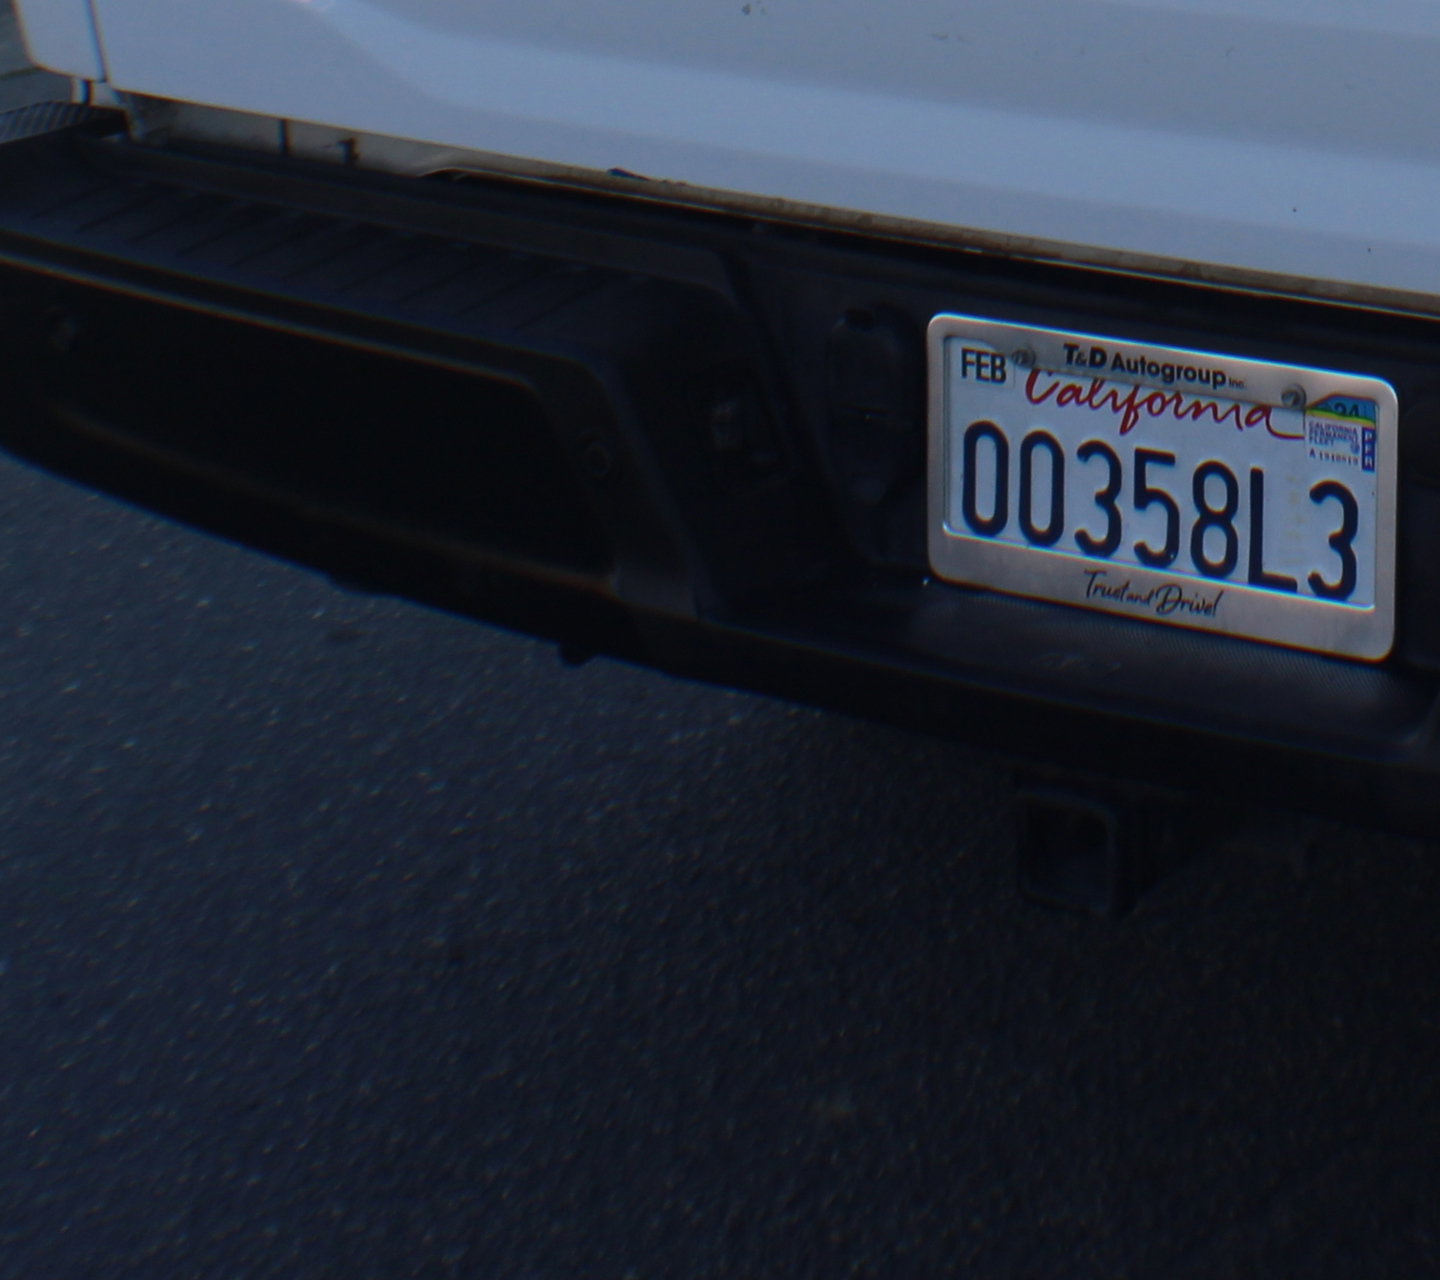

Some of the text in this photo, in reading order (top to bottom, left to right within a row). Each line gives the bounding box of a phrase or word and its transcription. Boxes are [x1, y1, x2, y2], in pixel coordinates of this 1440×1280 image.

[961, 347, 1007, 385] FEB
[1063, 342, 1108, 369] T&D
[1110, 351, 1227, 390] Autogroup
[1025, 367, 1305, 437] California
[962, 419, 1359, 602] 00358L3
[1083, 567, 1131, 603] Trust
